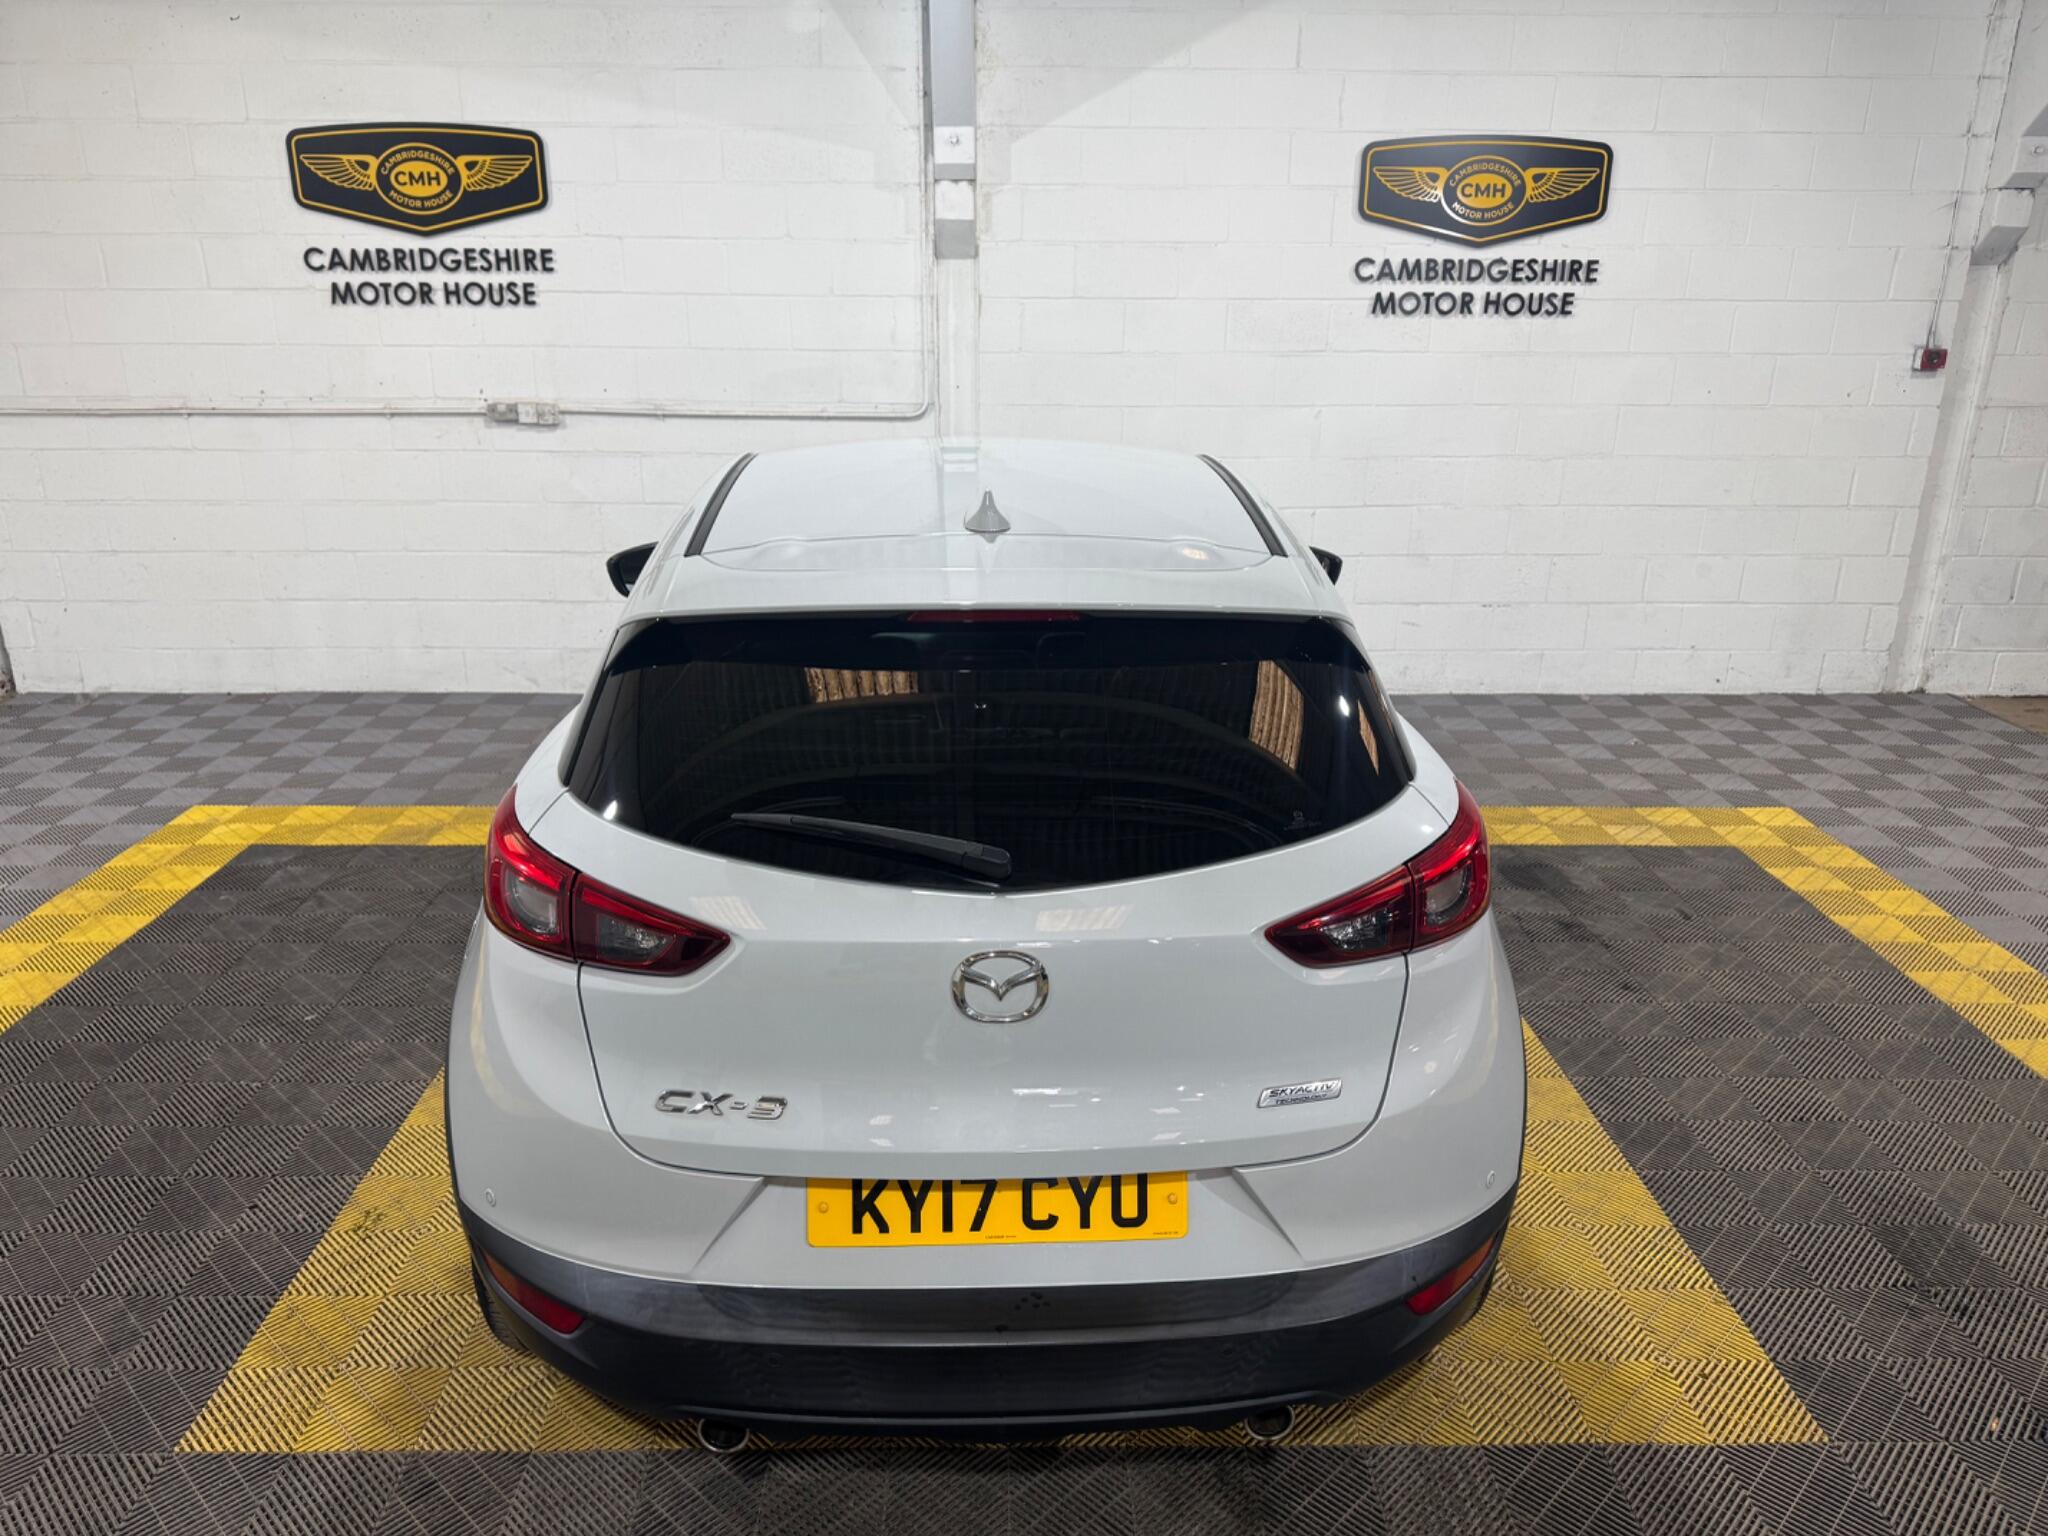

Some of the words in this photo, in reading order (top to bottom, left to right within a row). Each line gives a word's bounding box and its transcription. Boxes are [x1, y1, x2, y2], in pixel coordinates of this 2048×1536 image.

[380, 150, 455, 175] CAMBRIDGESHIRE
[1449, 162, 1521, 187] CAMBRIDGESHIRE
[394, 170, 441, 187] CMH
[1460, 182, 1507, 199] CMH
[389, 189, 422, 208] MOTOR
[424, 189, 454, 208] HOUSE
[1452, 201, 1482, 219] MOTOR
[1484, 201, 1514, 219] HOUSE
[303, 247, 555, 272] CAMBRIDGESHIRE
[1354, 258, 1600, 283] CAMBRIDGESHIRE
[331, 282, 434, 306] MOTOR
[443, 282, 538, 306] HOUSE
[1371, 292, 1475, 315] MOTOR
[1483, 292, 1576, 316] HOUSE
[1269, 1083, 1334, 1098] SKYACTIV
[655, 1089, 788, 1120] CX-3
[852, 1178, 998, 1234] KY17
